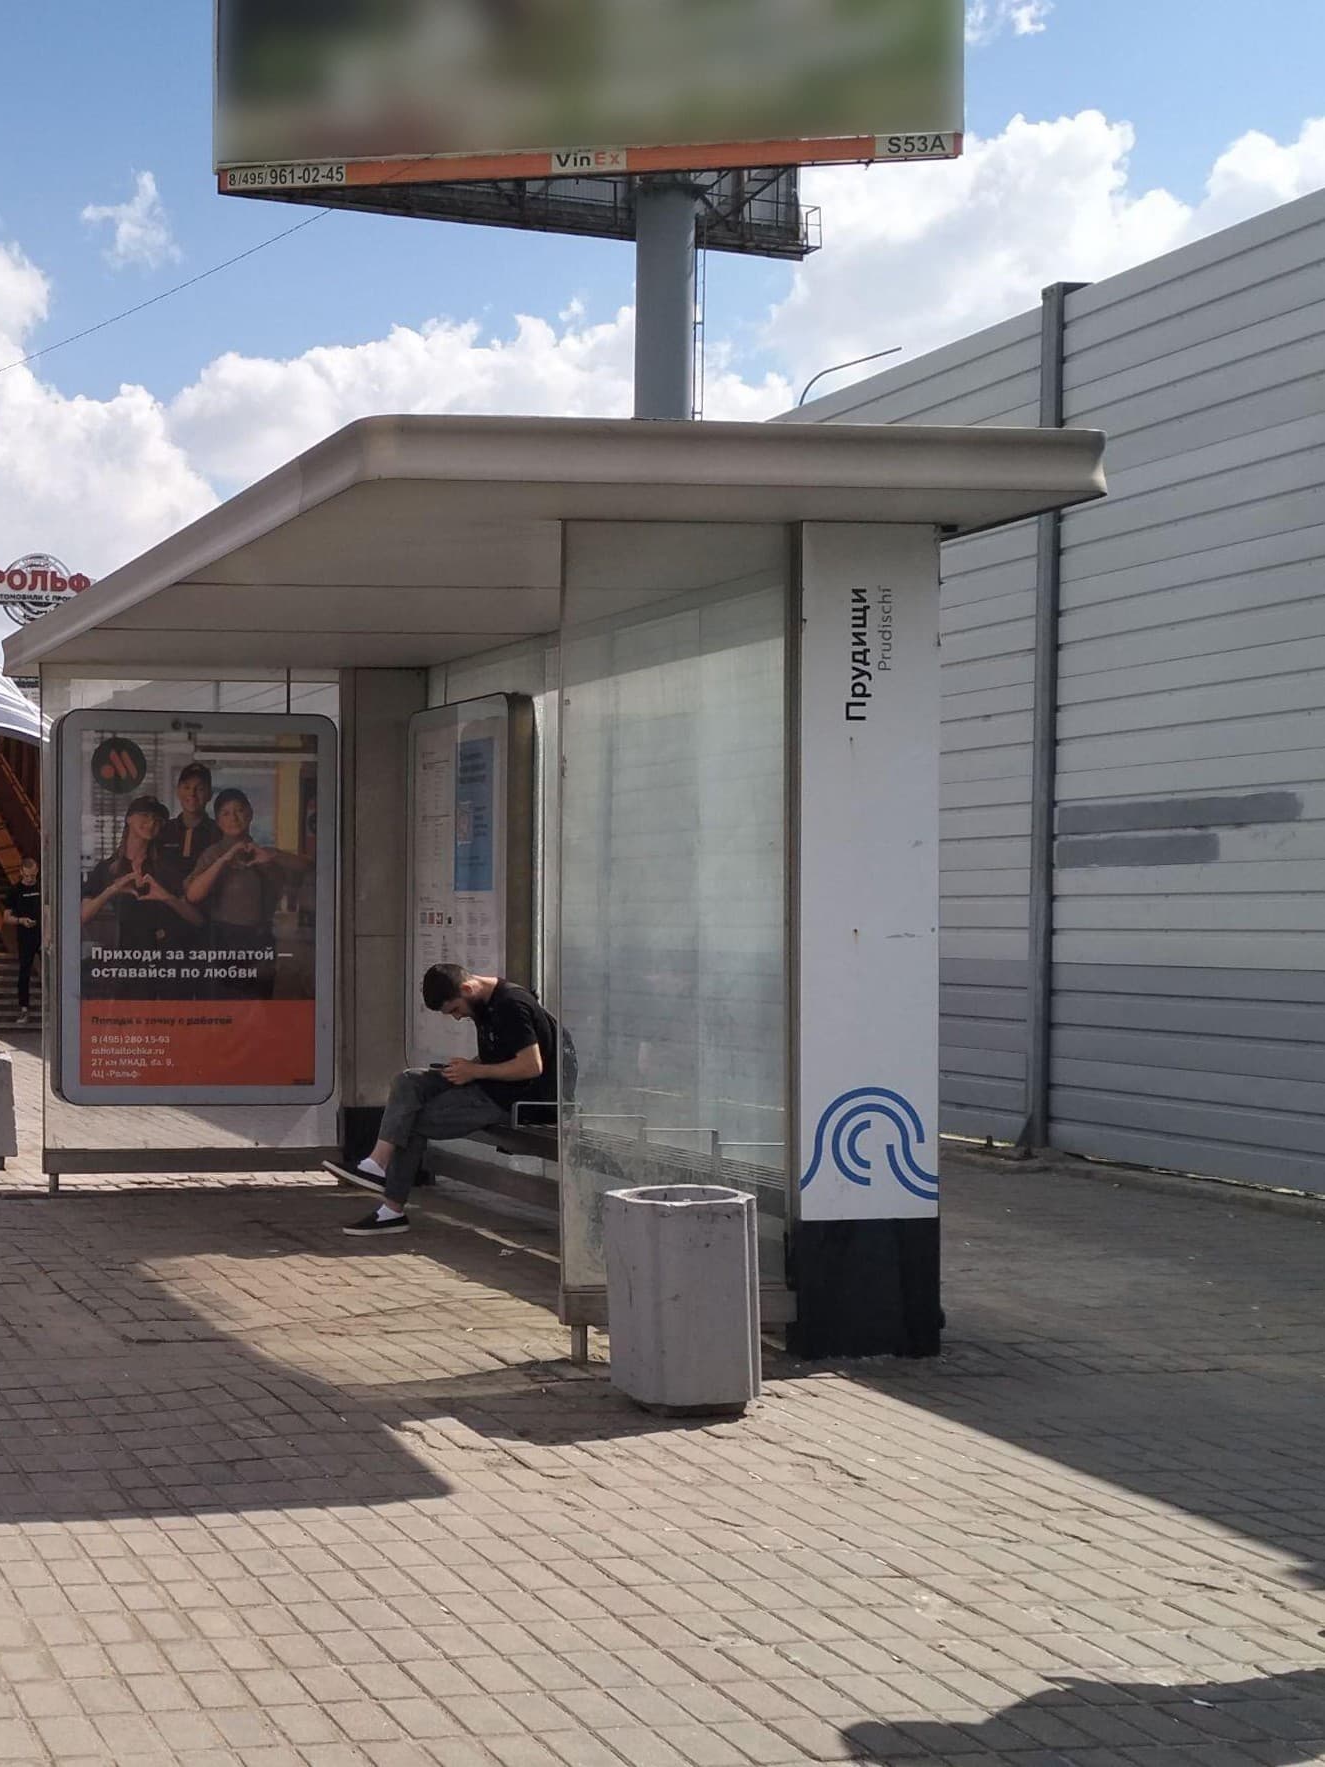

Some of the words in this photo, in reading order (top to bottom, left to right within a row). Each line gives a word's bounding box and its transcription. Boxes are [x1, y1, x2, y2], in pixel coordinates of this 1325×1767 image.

[887, 135, 946, 154] S53A
[555, 151, 621, 168] VinEx
[877, 585, 893, 671] Prudischi
[845, 588, 872, 721] Прудищи
[91, 946, 162, 963] Приходи
[166, 949, 184, 961] за
[189, 947, 274, 963] зарплатой
[91, 965, 177, 979] оставайся
[181, 967, 200, 979] по
[204, 965, 258, 979] любви
[99, 1035, 123, 1045] (495)
[91, 1058, 102, 1066] 27
